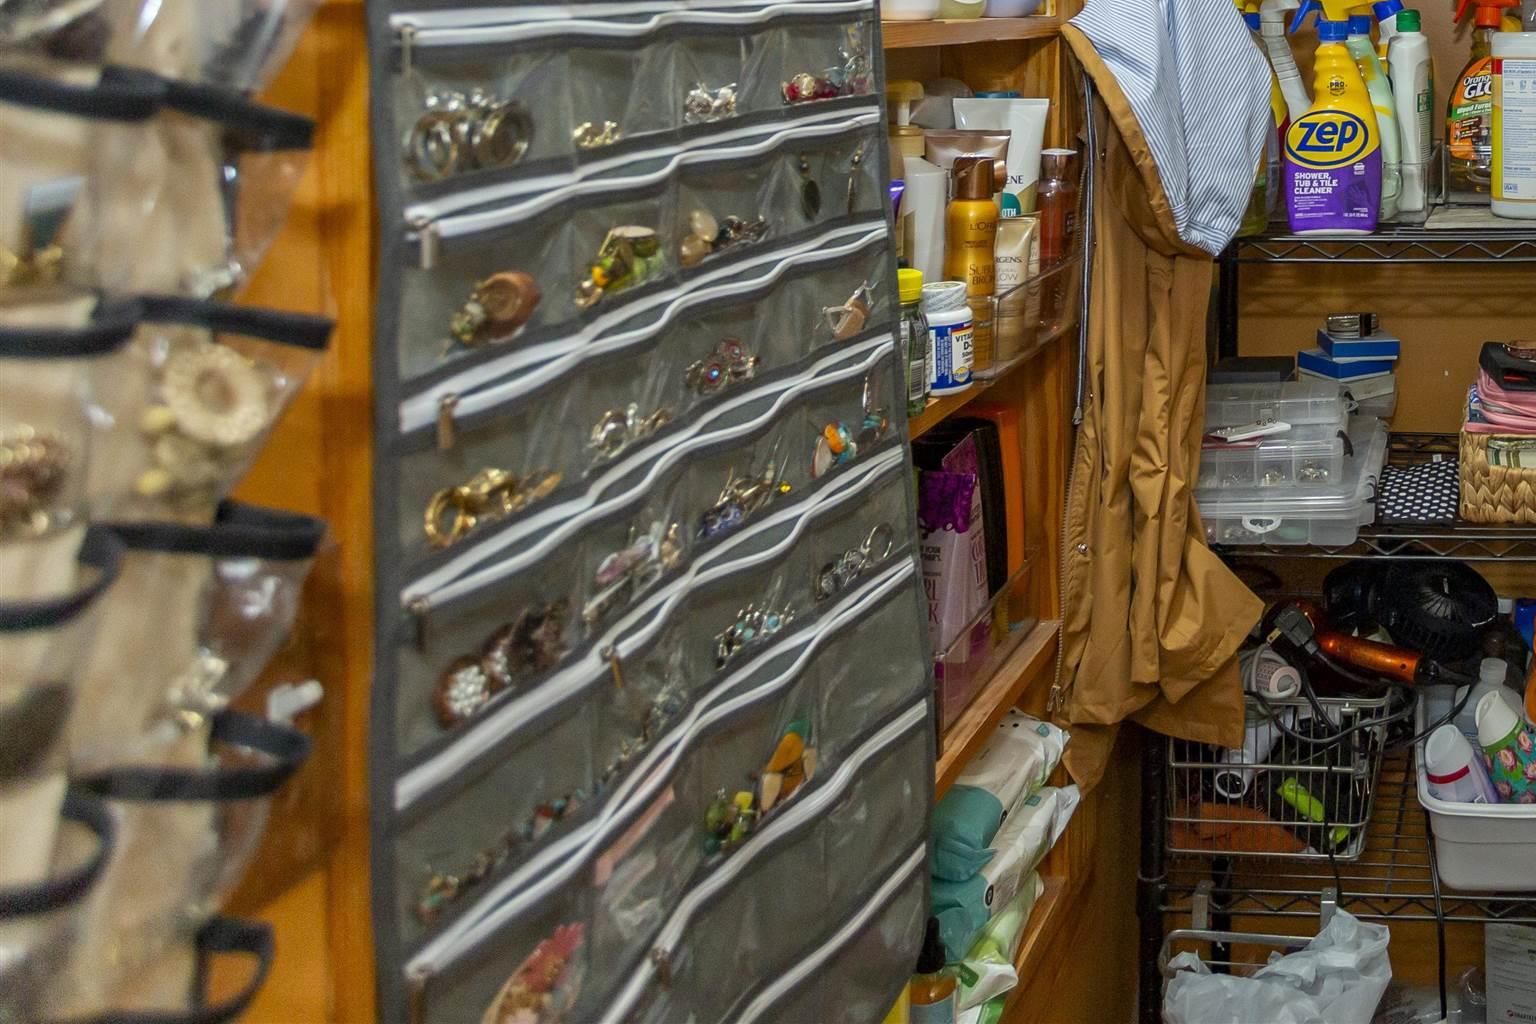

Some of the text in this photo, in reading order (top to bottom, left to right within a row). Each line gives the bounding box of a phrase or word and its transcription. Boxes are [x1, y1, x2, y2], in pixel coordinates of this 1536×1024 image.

[1006, 175, 1023, 184] ENE
[1294, 172, 1332, 180] SHOWER,
[1294, 179, 1338, 187] TUB & TILE
[1002, 208, 1016, 217] OTH
[995, 256, 1022, 264] RGENS
[955, 334, 973, 342] VITA
